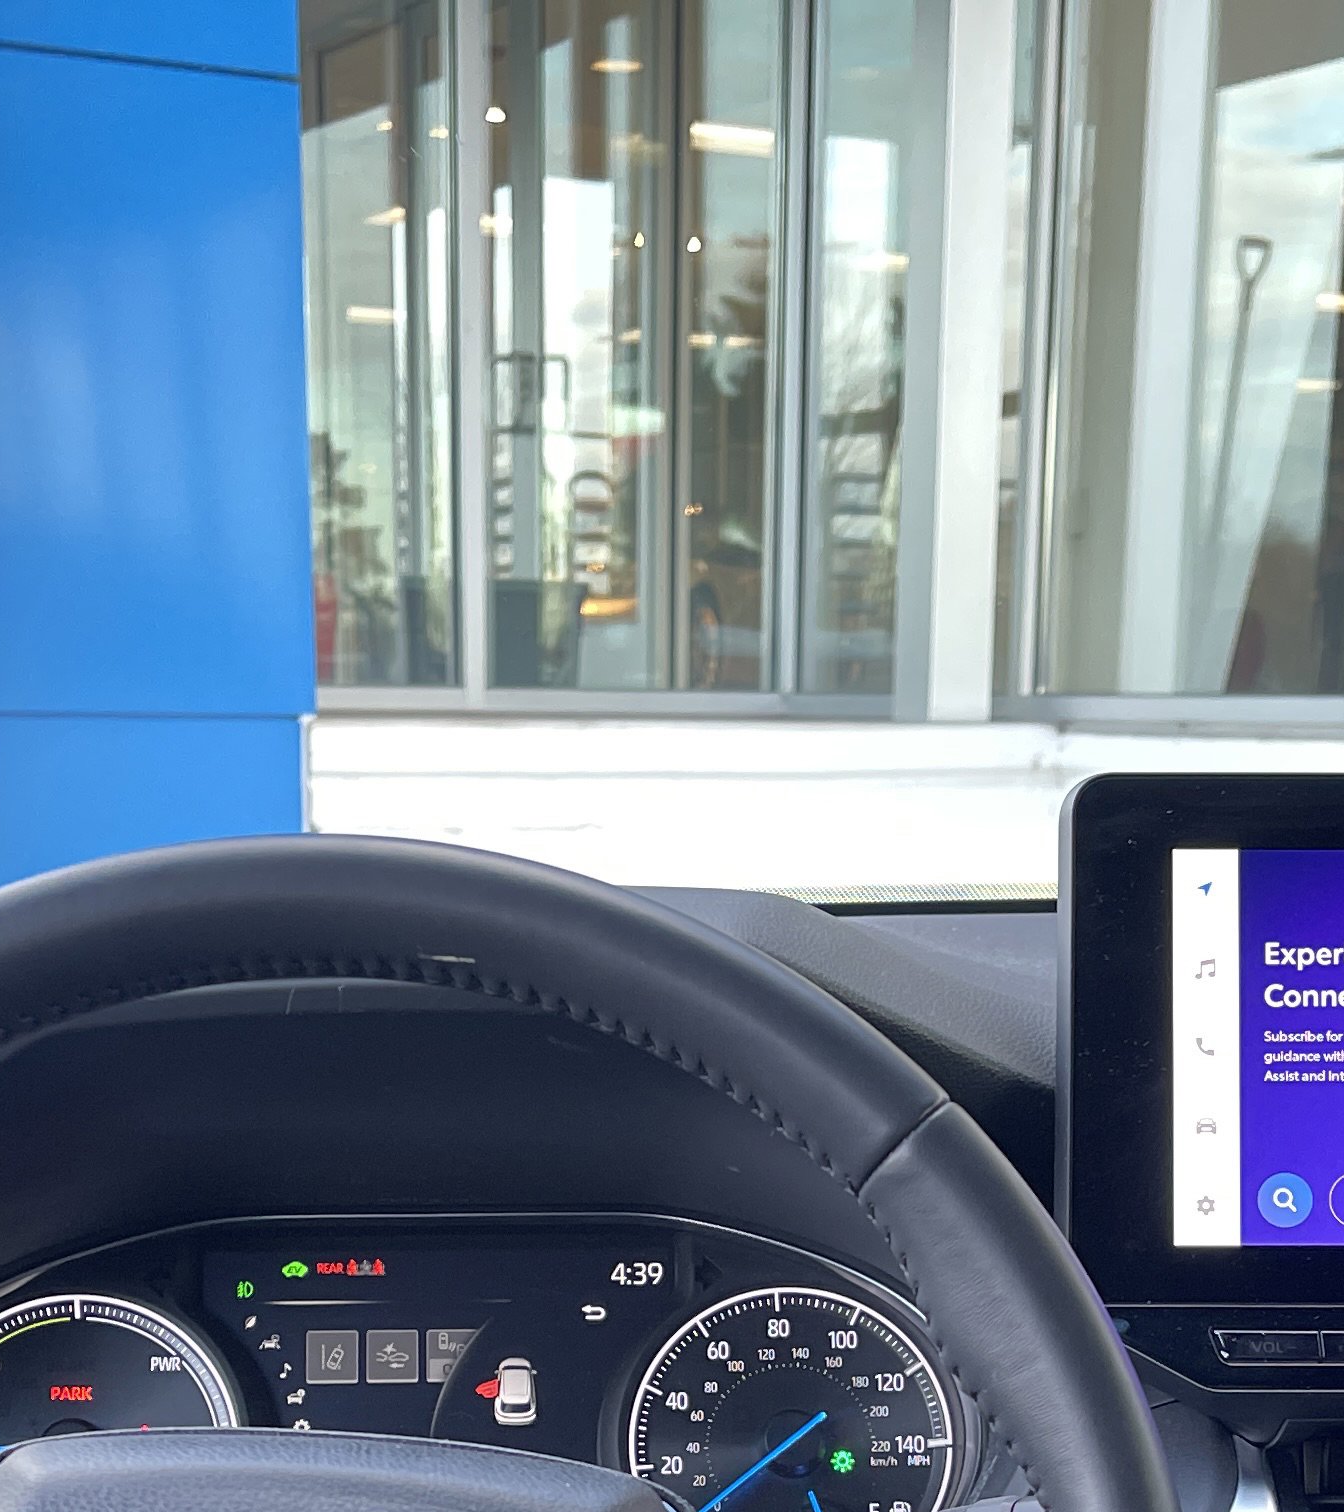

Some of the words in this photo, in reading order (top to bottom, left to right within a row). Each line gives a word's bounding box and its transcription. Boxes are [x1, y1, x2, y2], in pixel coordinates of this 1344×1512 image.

[1264, 1031, 1324, 1042] Subscribe
[1326, 1030, 1343, 1042] for
[1264, 1050, 1320, 1064] guidance
[1264, 1070, 1299, 1081] Assist
[1302, 1070, 1325, 1081] and
[317, 1263, 343, 1274] REAR
[611, 1263, 662, 1285] 4:39
[768, 1319, 789, 1337] 80
[828, 1331, 857, 1349] 100
[707, 1341, 729, 1359] 60
[758, 1349, 775, 1360] 120
[792, 1348, 809, 1359] 140
[150, 1357, 181, 1372] PWR
[727, 1361, 744, 1372] 100
[825, 1357, 842, 1367] 160
[852, 1376, 869, 1387] 180
[875, 1373, 904, 1392] 120
[704, 1382, 717, 1393] 80
[51, 1387, 92, 1400] PARK
[666, 1392, 688, 1410] 40
[691, 1410, 704, 1421] 60
[870, 1406, 889, 1417] 200
[686, 1443, 700, 1453] 40
[871, 1441, 890, 1452] 220
[895, 1435, 924, 1453] 140
[661, 1456, 682, 1474] 20
[871, 1456, 897, 1466] km/h
[908, 1455, 930, 1466] MPH
[693, 1475, 706, 1486] 20
